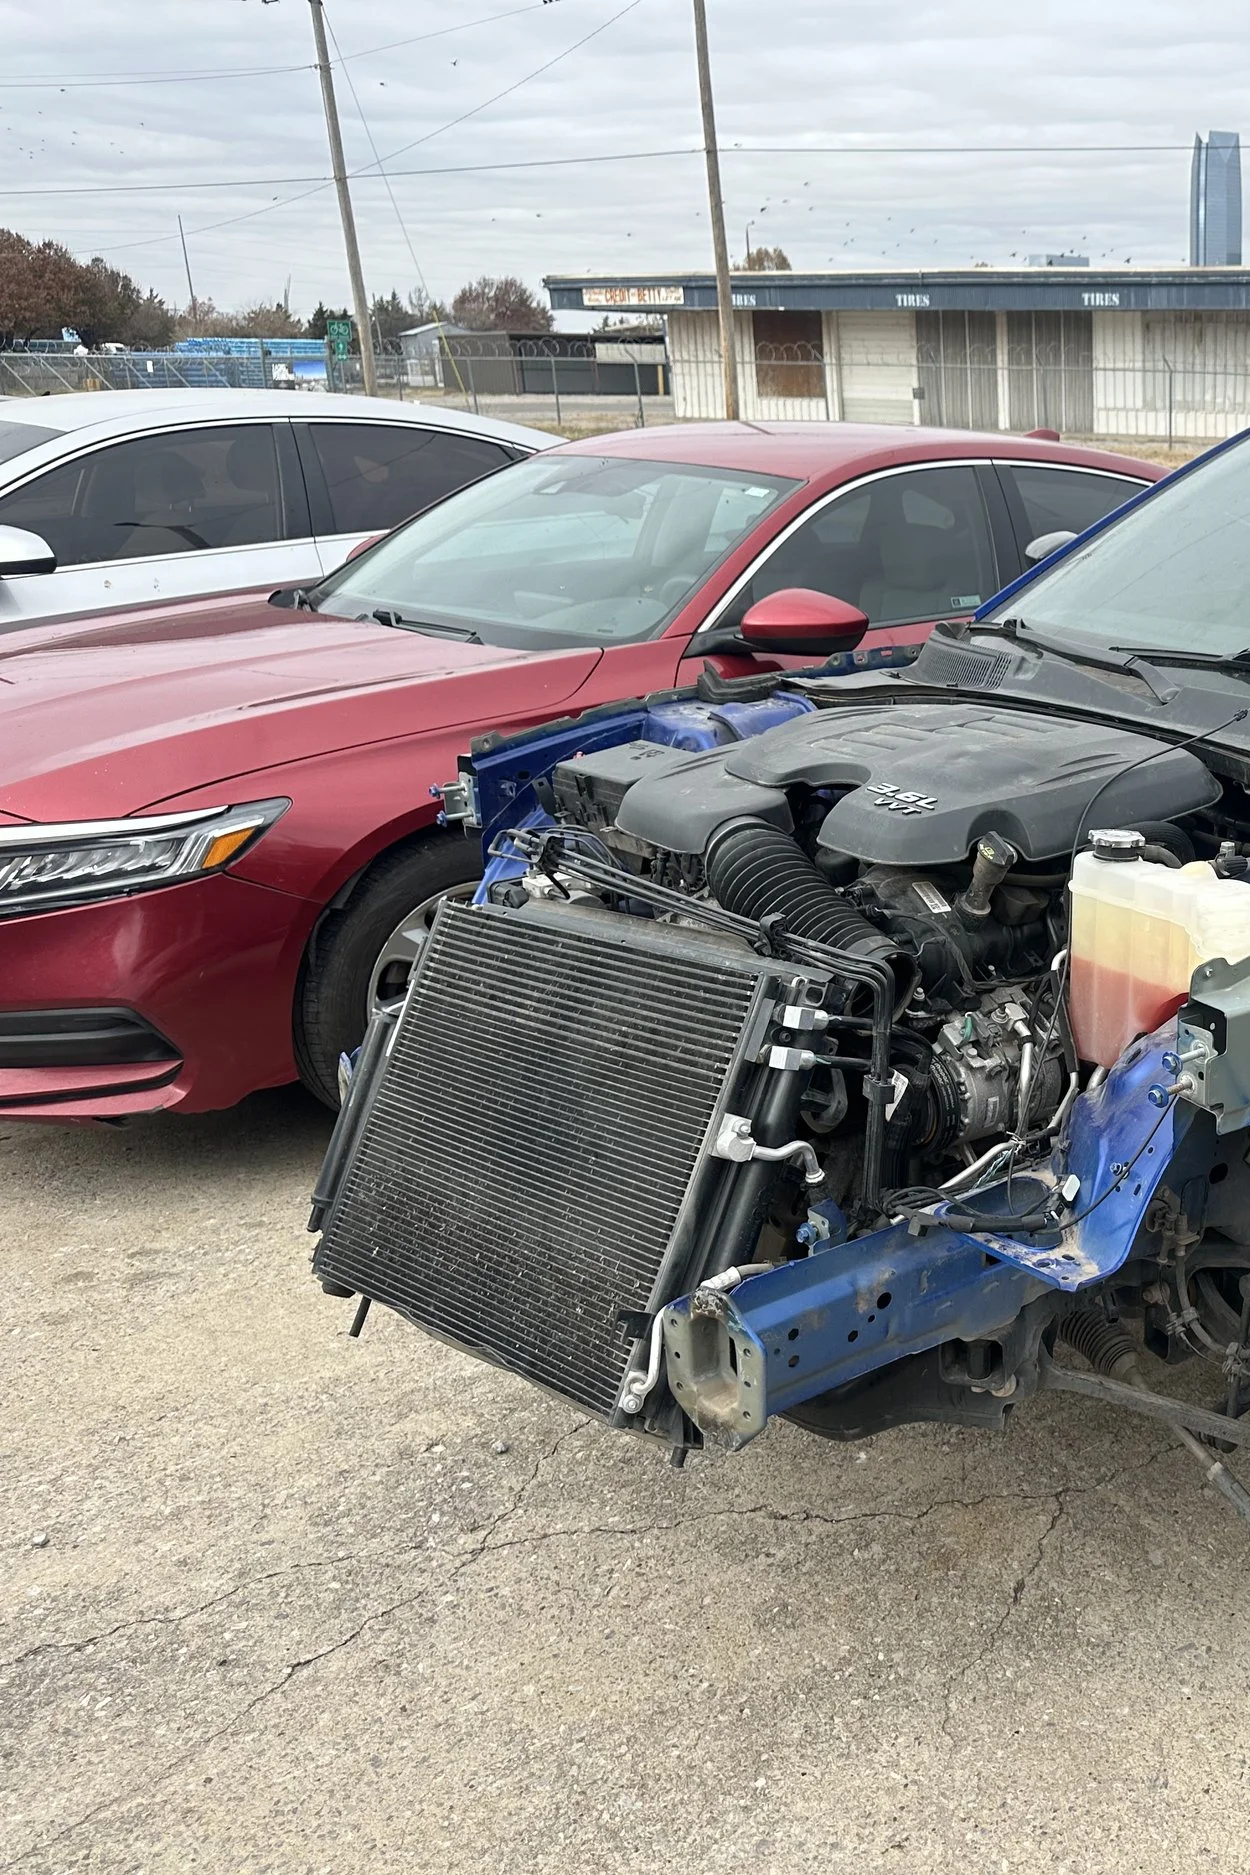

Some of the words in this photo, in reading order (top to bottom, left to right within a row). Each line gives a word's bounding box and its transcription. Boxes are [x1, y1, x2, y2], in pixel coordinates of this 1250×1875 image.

[732, 294, 756, 306] IRES
[896, 294, 930, 307] TIRES
[1082, 293, 1120, 306] TIRES
[867, 782, 938, 810] 3.6L
[874, 797, 922, 815] VVT
